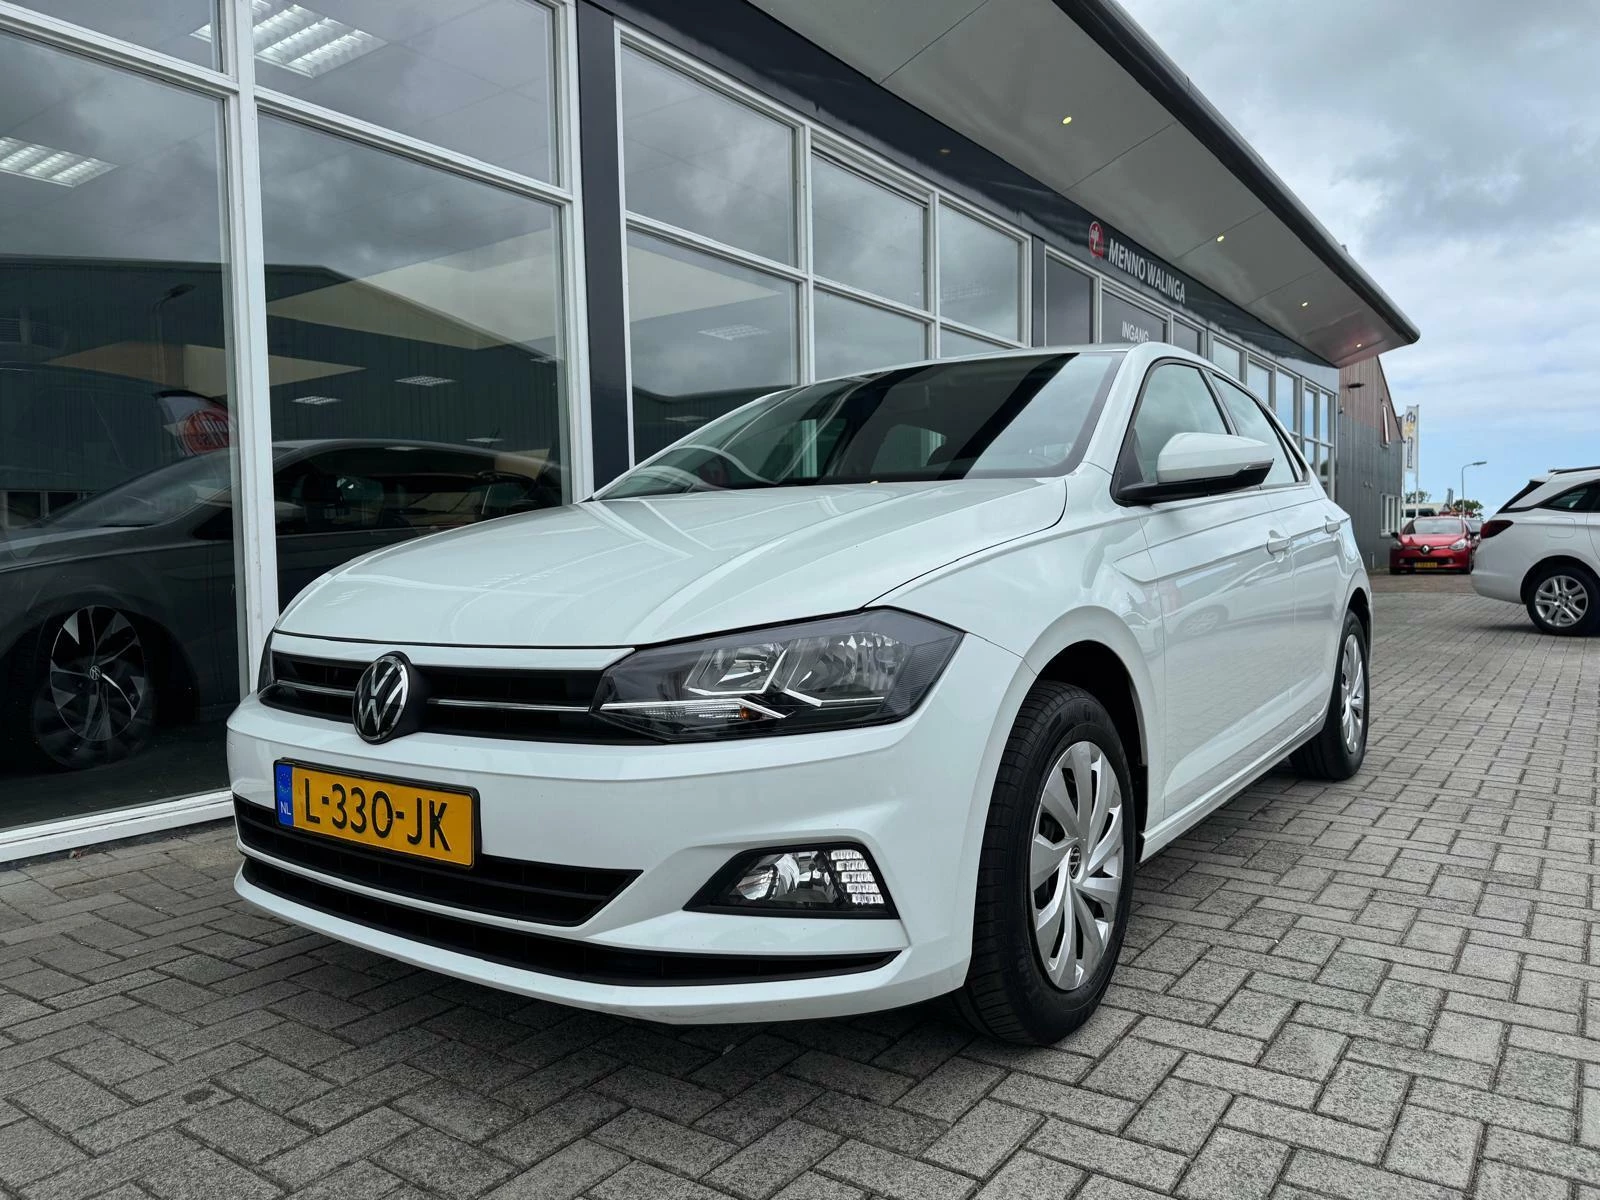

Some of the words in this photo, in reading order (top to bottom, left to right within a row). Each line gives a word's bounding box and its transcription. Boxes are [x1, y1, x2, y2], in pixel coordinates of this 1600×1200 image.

[1108, 238, 1146, 281] MENNO
[1146, 261, 1186, 304] WALINGA
[1121, 321, 1149, 342] INGANG
[280, 801, 292, 816] NL
[304, 777, 451, 852] L-330-JK
